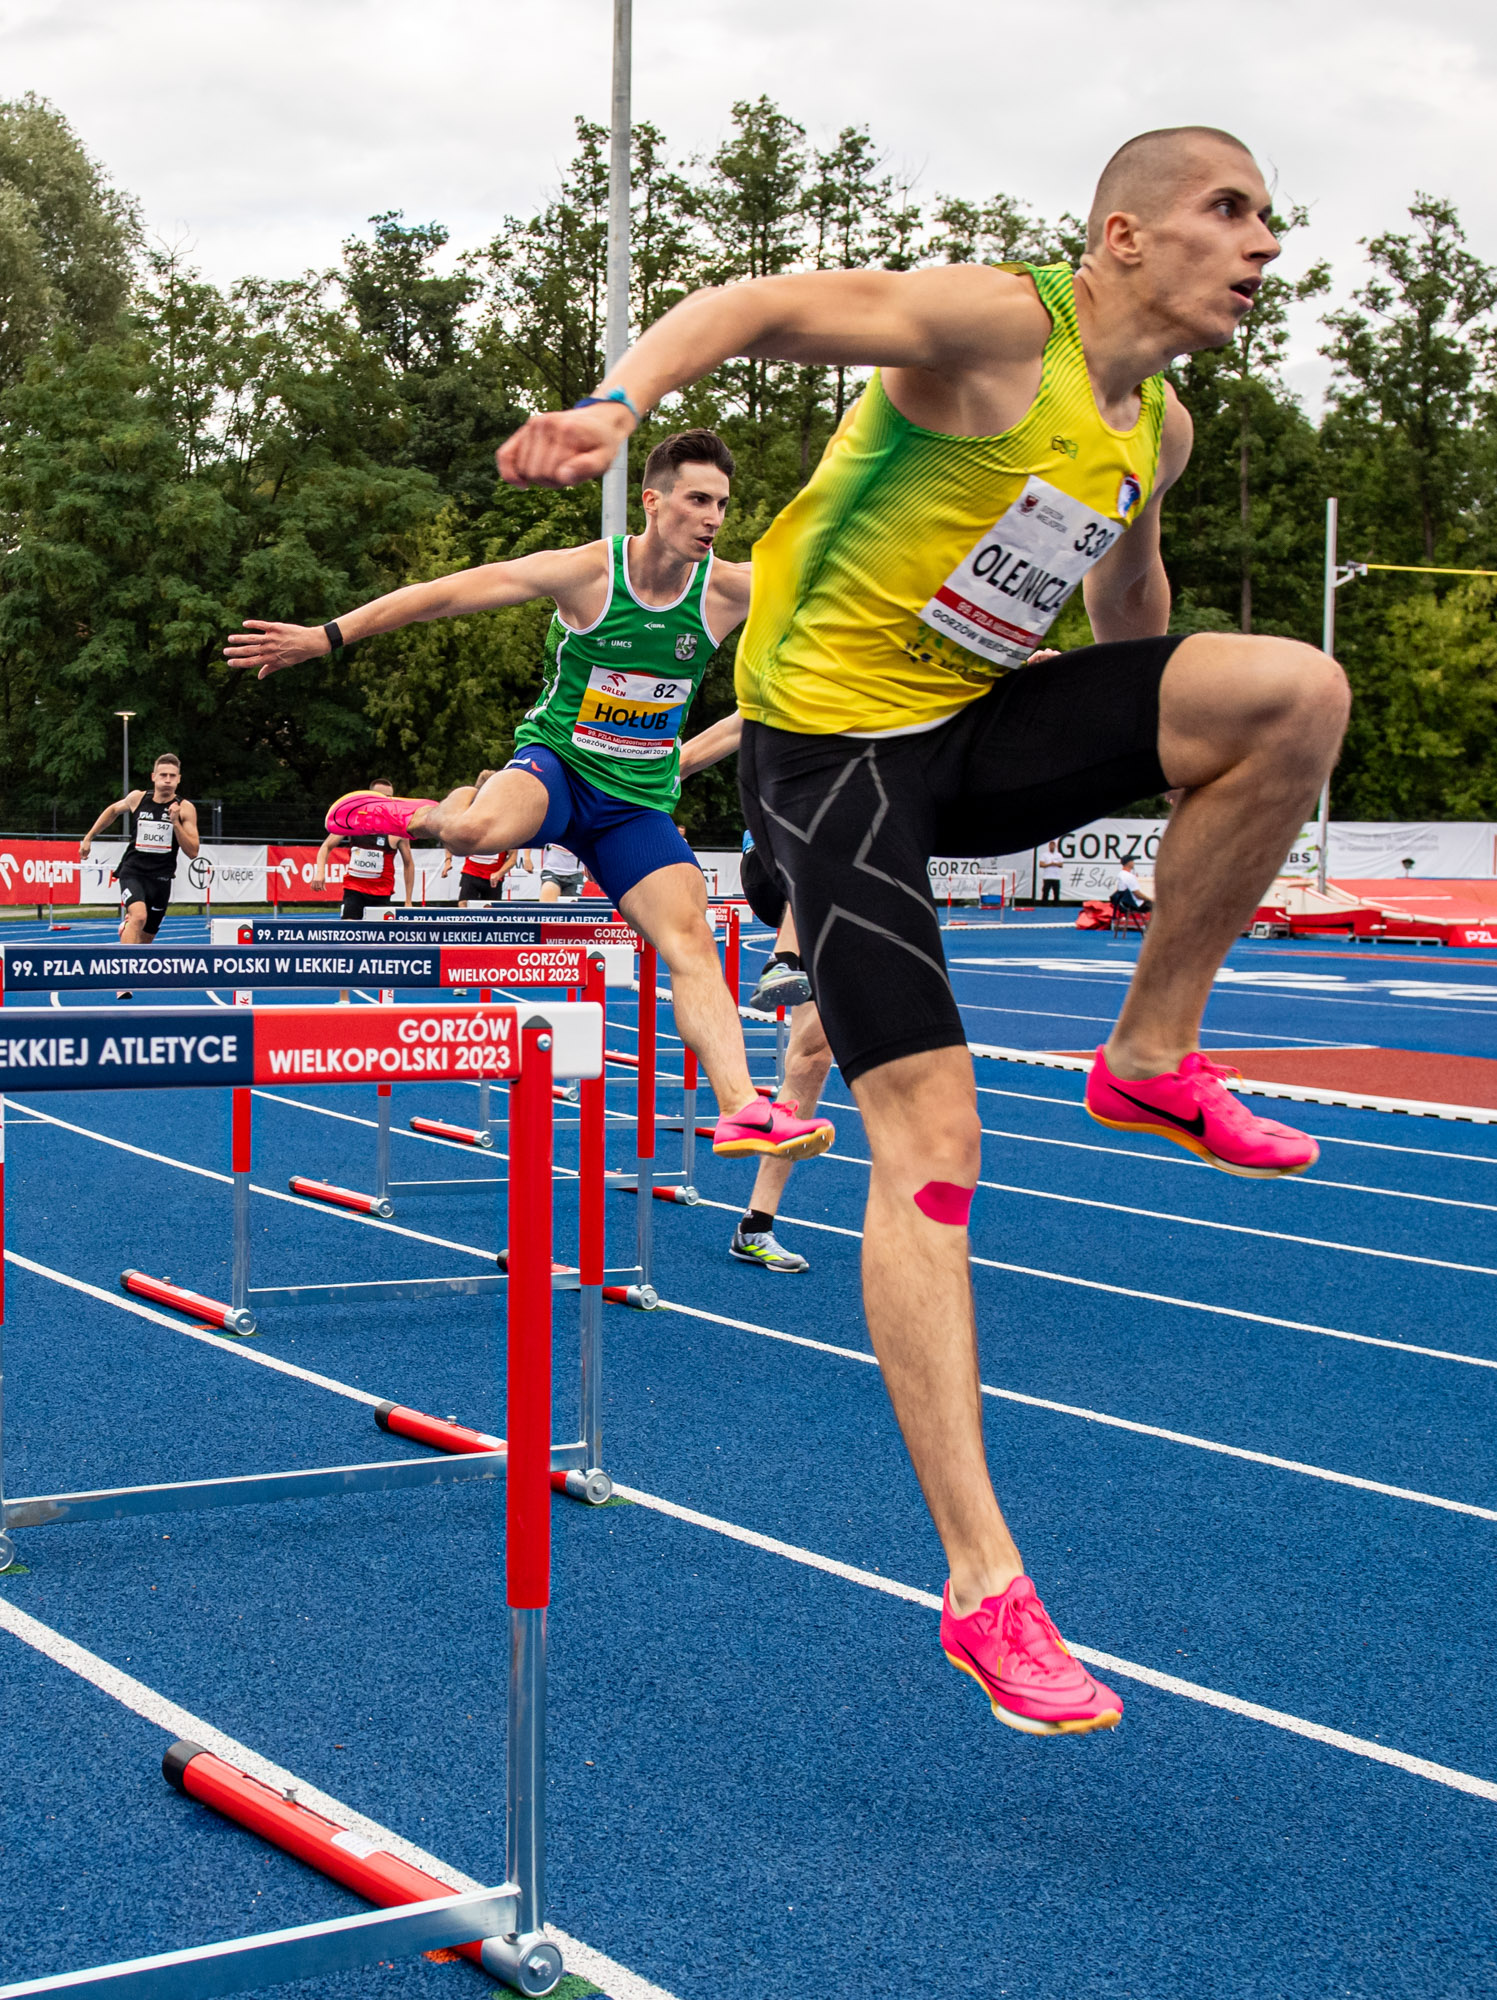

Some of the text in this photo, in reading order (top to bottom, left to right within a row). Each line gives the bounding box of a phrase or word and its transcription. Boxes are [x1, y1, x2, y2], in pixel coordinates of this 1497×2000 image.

[972, 544, 1075, 613] OLEJNICZA
[611, 640, 632, 648] UMCS
[601, 684, 626, 697] ORLEN
[653, 683, 677, 698] 82
[594, 703, 669, 731] HOŁUB
[598, 732, 612, 741] PZLA
[576, 737, 607, 748] GORZÓW
[608, 746, 652, 755] WIELKOPOLSKI
[143, 833, 165, 842] BUCK
[1058, 827, 1161, 859] GORZÓ
[1289, 852, 1311, 863] BS
[23, 859, 73, 883] ORLEN
[257, 929, 535, 943] 99. PZLA MISTRZOSTWA POLSKI W LEKKIEJ ATLETYCE
[594, 926, 638, 939] GORZÓW
[1464, 931, 1497, 943] PZL
[517, 949, 580, 967] GORZÓW
[12, 957, 432, 977] 99. PZLA MISTRZOSTWA POLSKI W LEKKIEJ ATLETYCE
[448, 967, 580, 983] WIELKOPOLSKI 2023
[398, 1012, 511, 1044] GORZÓW
[0, 1035, 238, 1068] EKKIEJ ATLETYCE
[269, 1046, 511, 1074] WIELKOPOLSKI 2023
